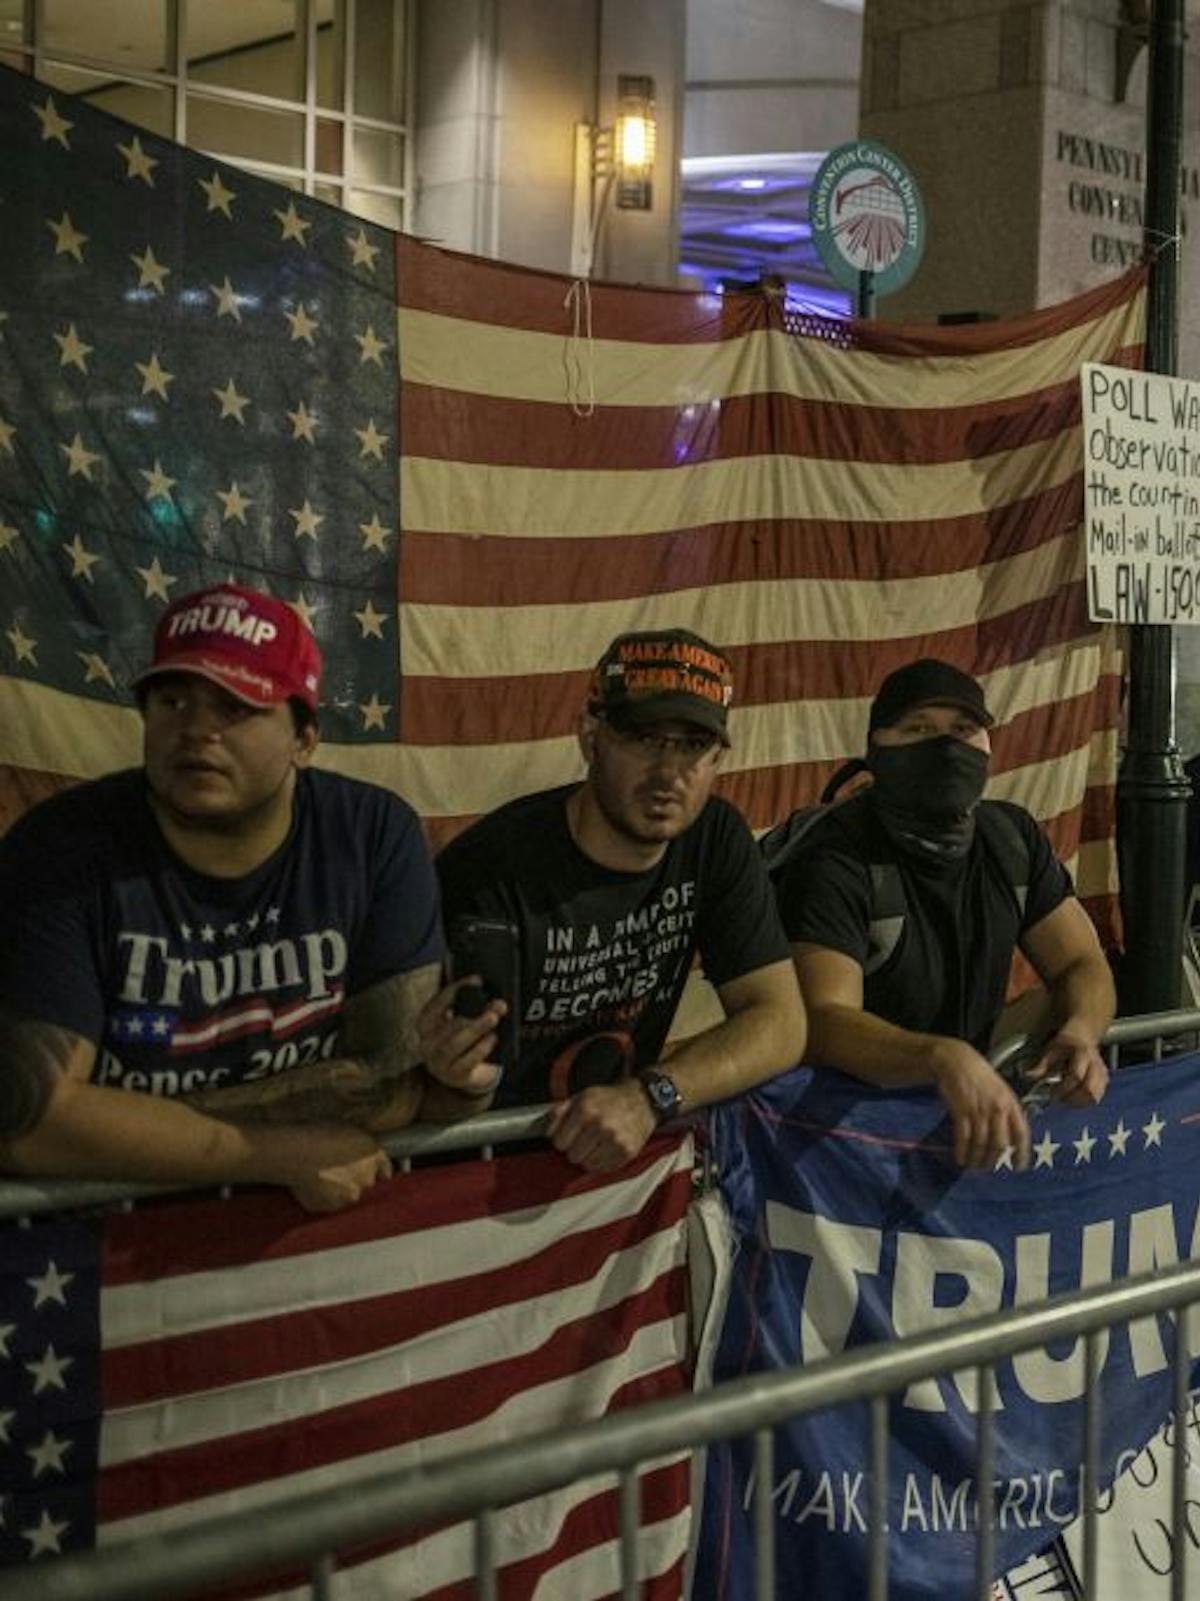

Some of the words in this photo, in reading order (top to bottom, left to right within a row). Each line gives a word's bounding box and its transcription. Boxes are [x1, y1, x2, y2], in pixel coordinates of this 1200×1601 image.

[1057, 131, 1199, 200] PENNSYLIA
[1091, 233, 1143, 266] CENT
[1090, 370, 1158, 424] POLL
[167, 604, 278, 646] TRUMP
[546, 927, 574, 955] IN
[661, 881, 695, 913] OF
[116, 927, 349, 1007] Trump
[743, 1470, 872, 1533] MAK
